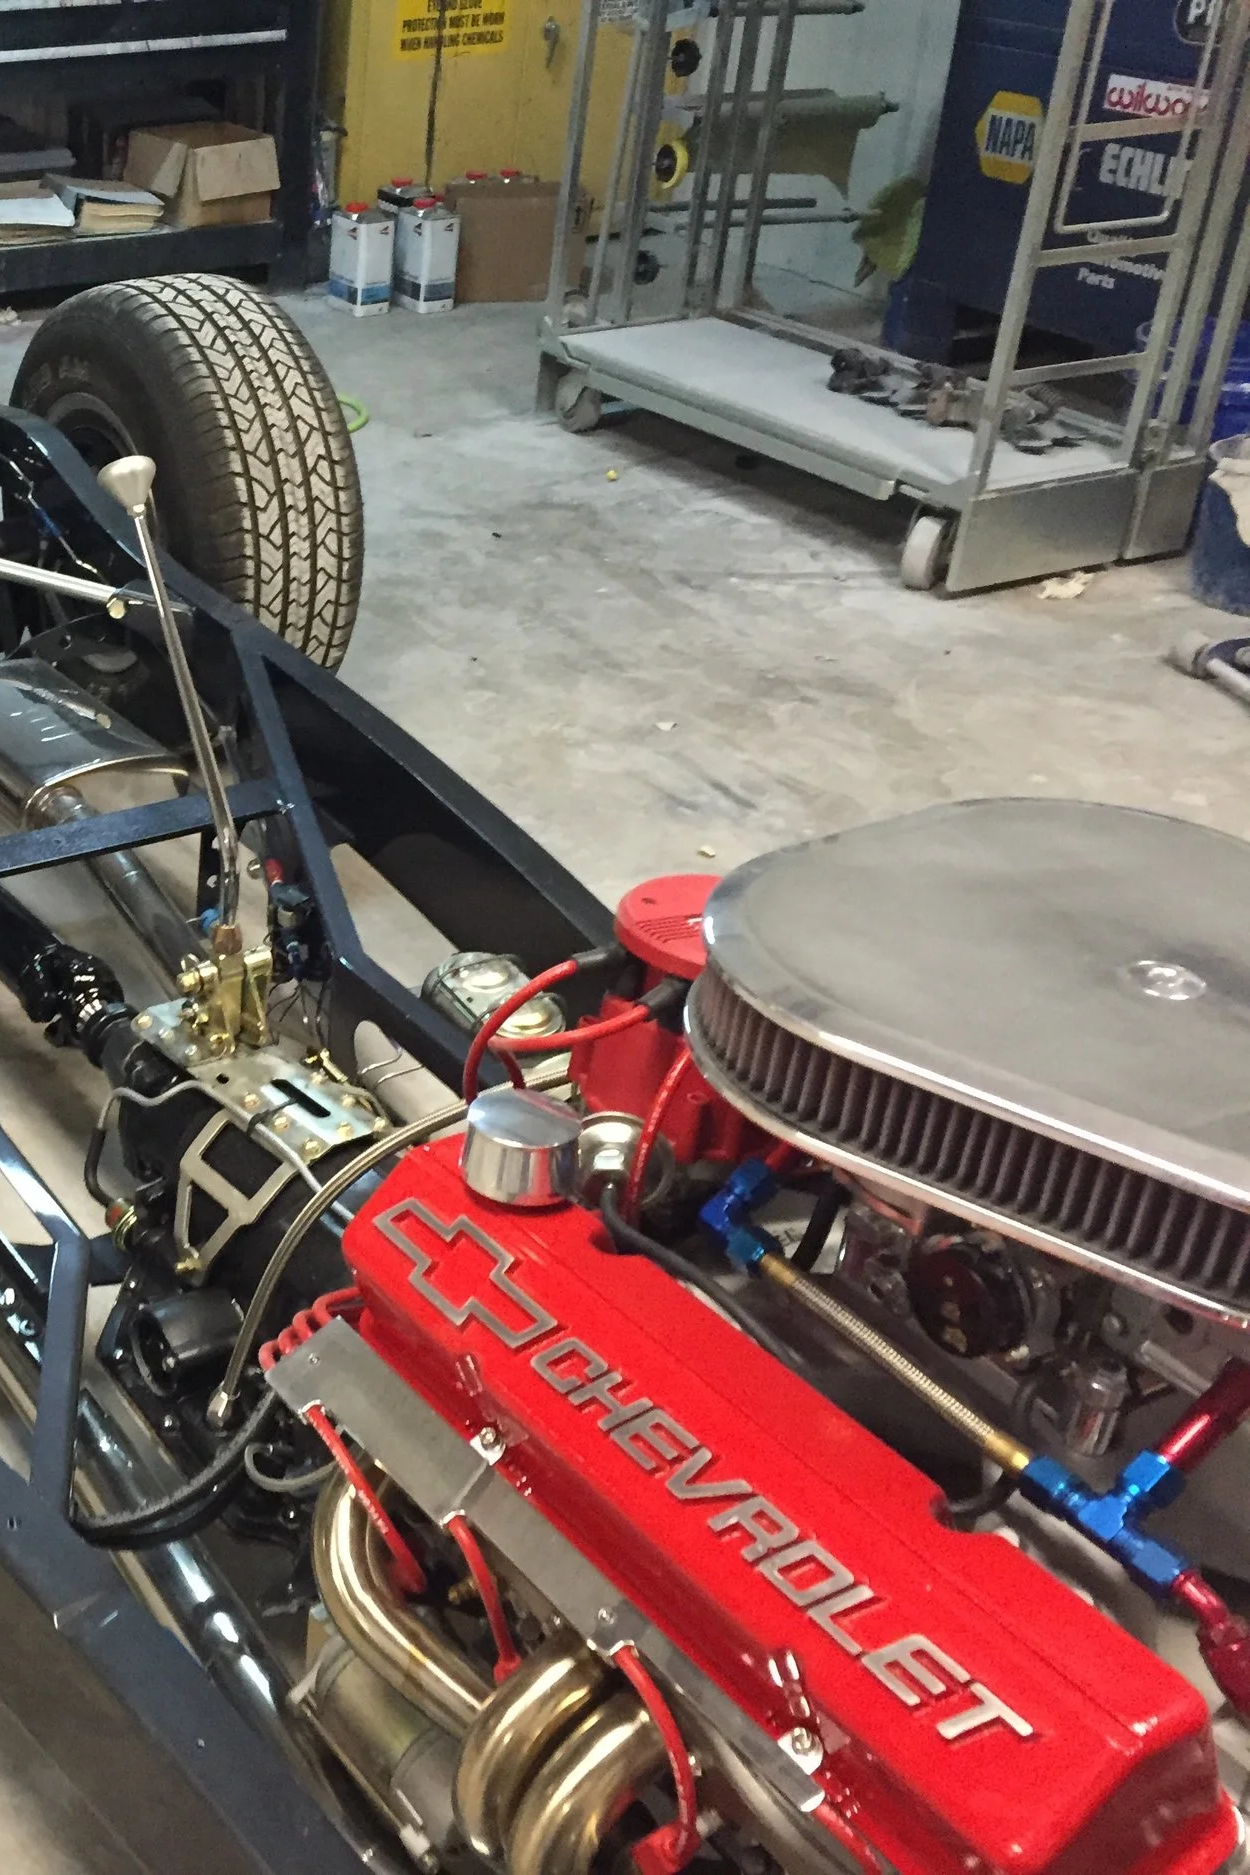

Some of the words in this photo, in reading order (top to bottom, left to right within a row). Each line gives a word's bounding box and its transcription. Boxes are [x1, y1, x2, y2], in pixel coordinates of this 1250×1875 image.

[402, 17, 447, 32] PROTECT
[423, 33, 460, 49] HANLING
[985, 114, 1036, 161] NAPA
[1099, 143, 1187, 196] ECHL
[530, 1337, 1033, 1741] CHEVROLET
